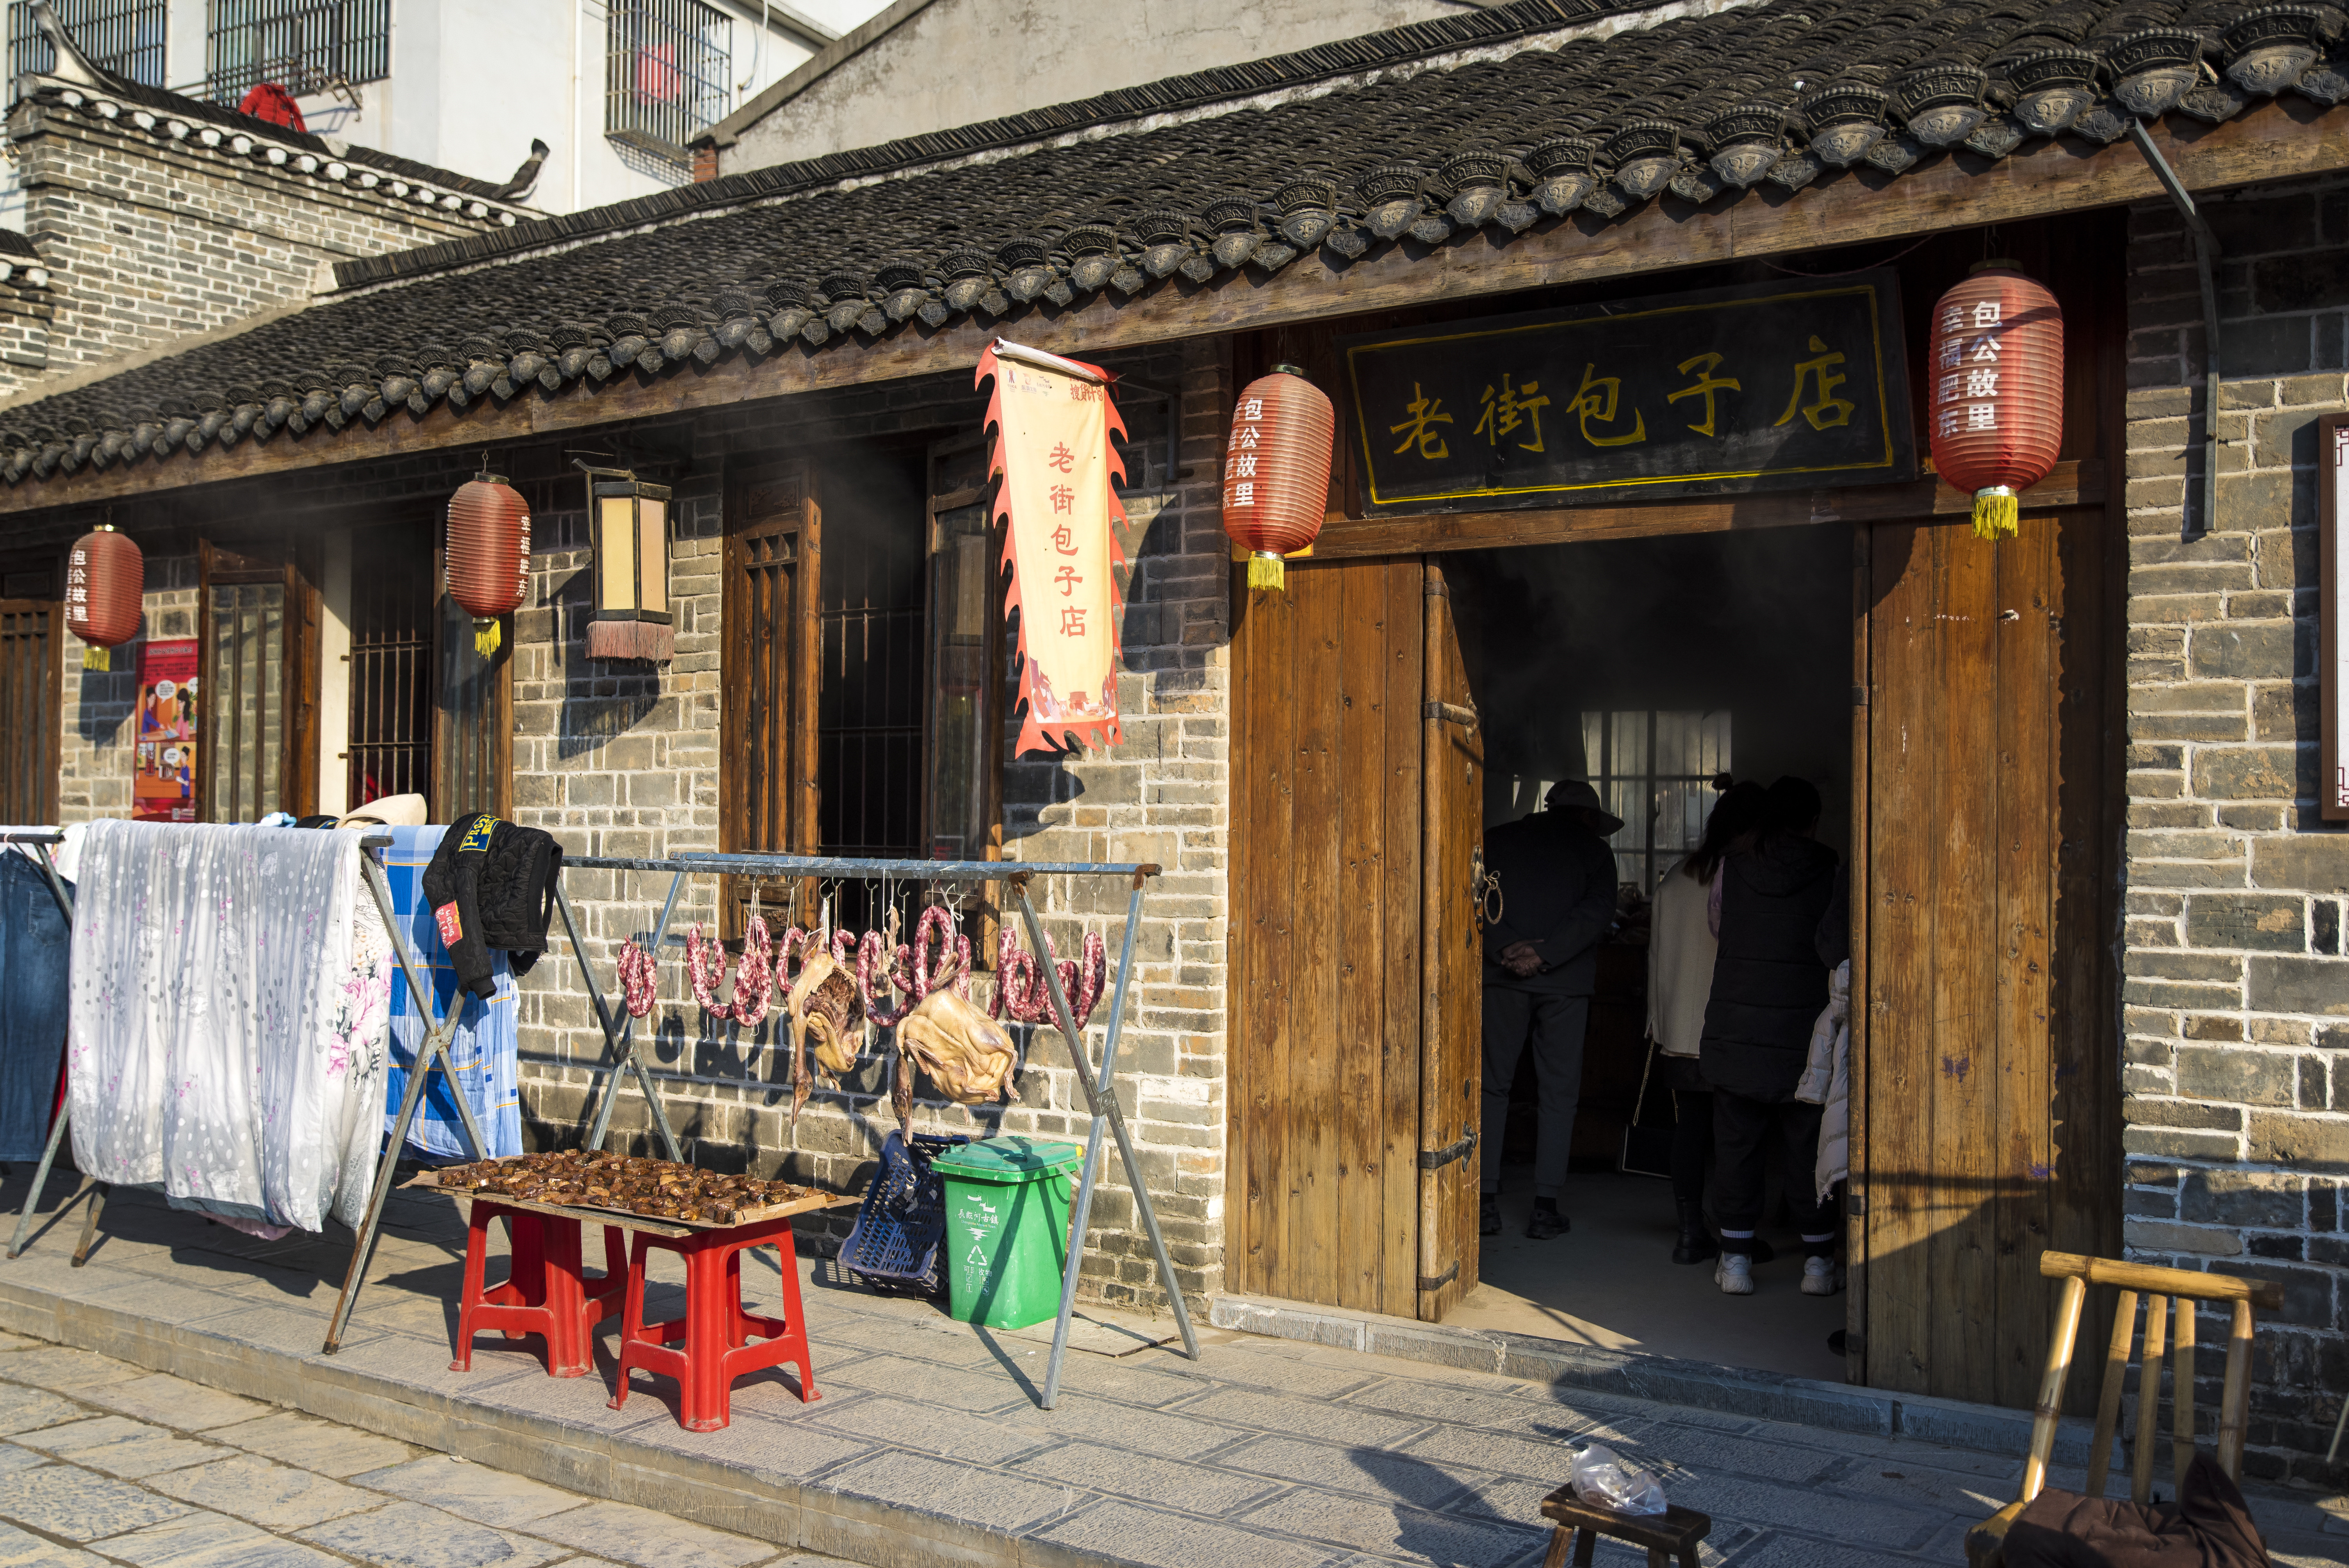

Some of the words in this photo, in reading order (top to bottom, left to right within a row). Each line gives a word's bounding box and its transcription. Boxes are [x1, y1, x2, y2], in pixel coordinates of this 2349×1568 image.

[1390, 335, 1855, 460] 老街包子店
[1937, 306, 1963, 438] 幸福肥东
[1966, 301, 2002, 433] 包公故里
[1233, 397, 1262, 507] 包公故里
[72, 549, 89, 622] 包公故里
[1049, 442, 1087, 637] 老街包子店
